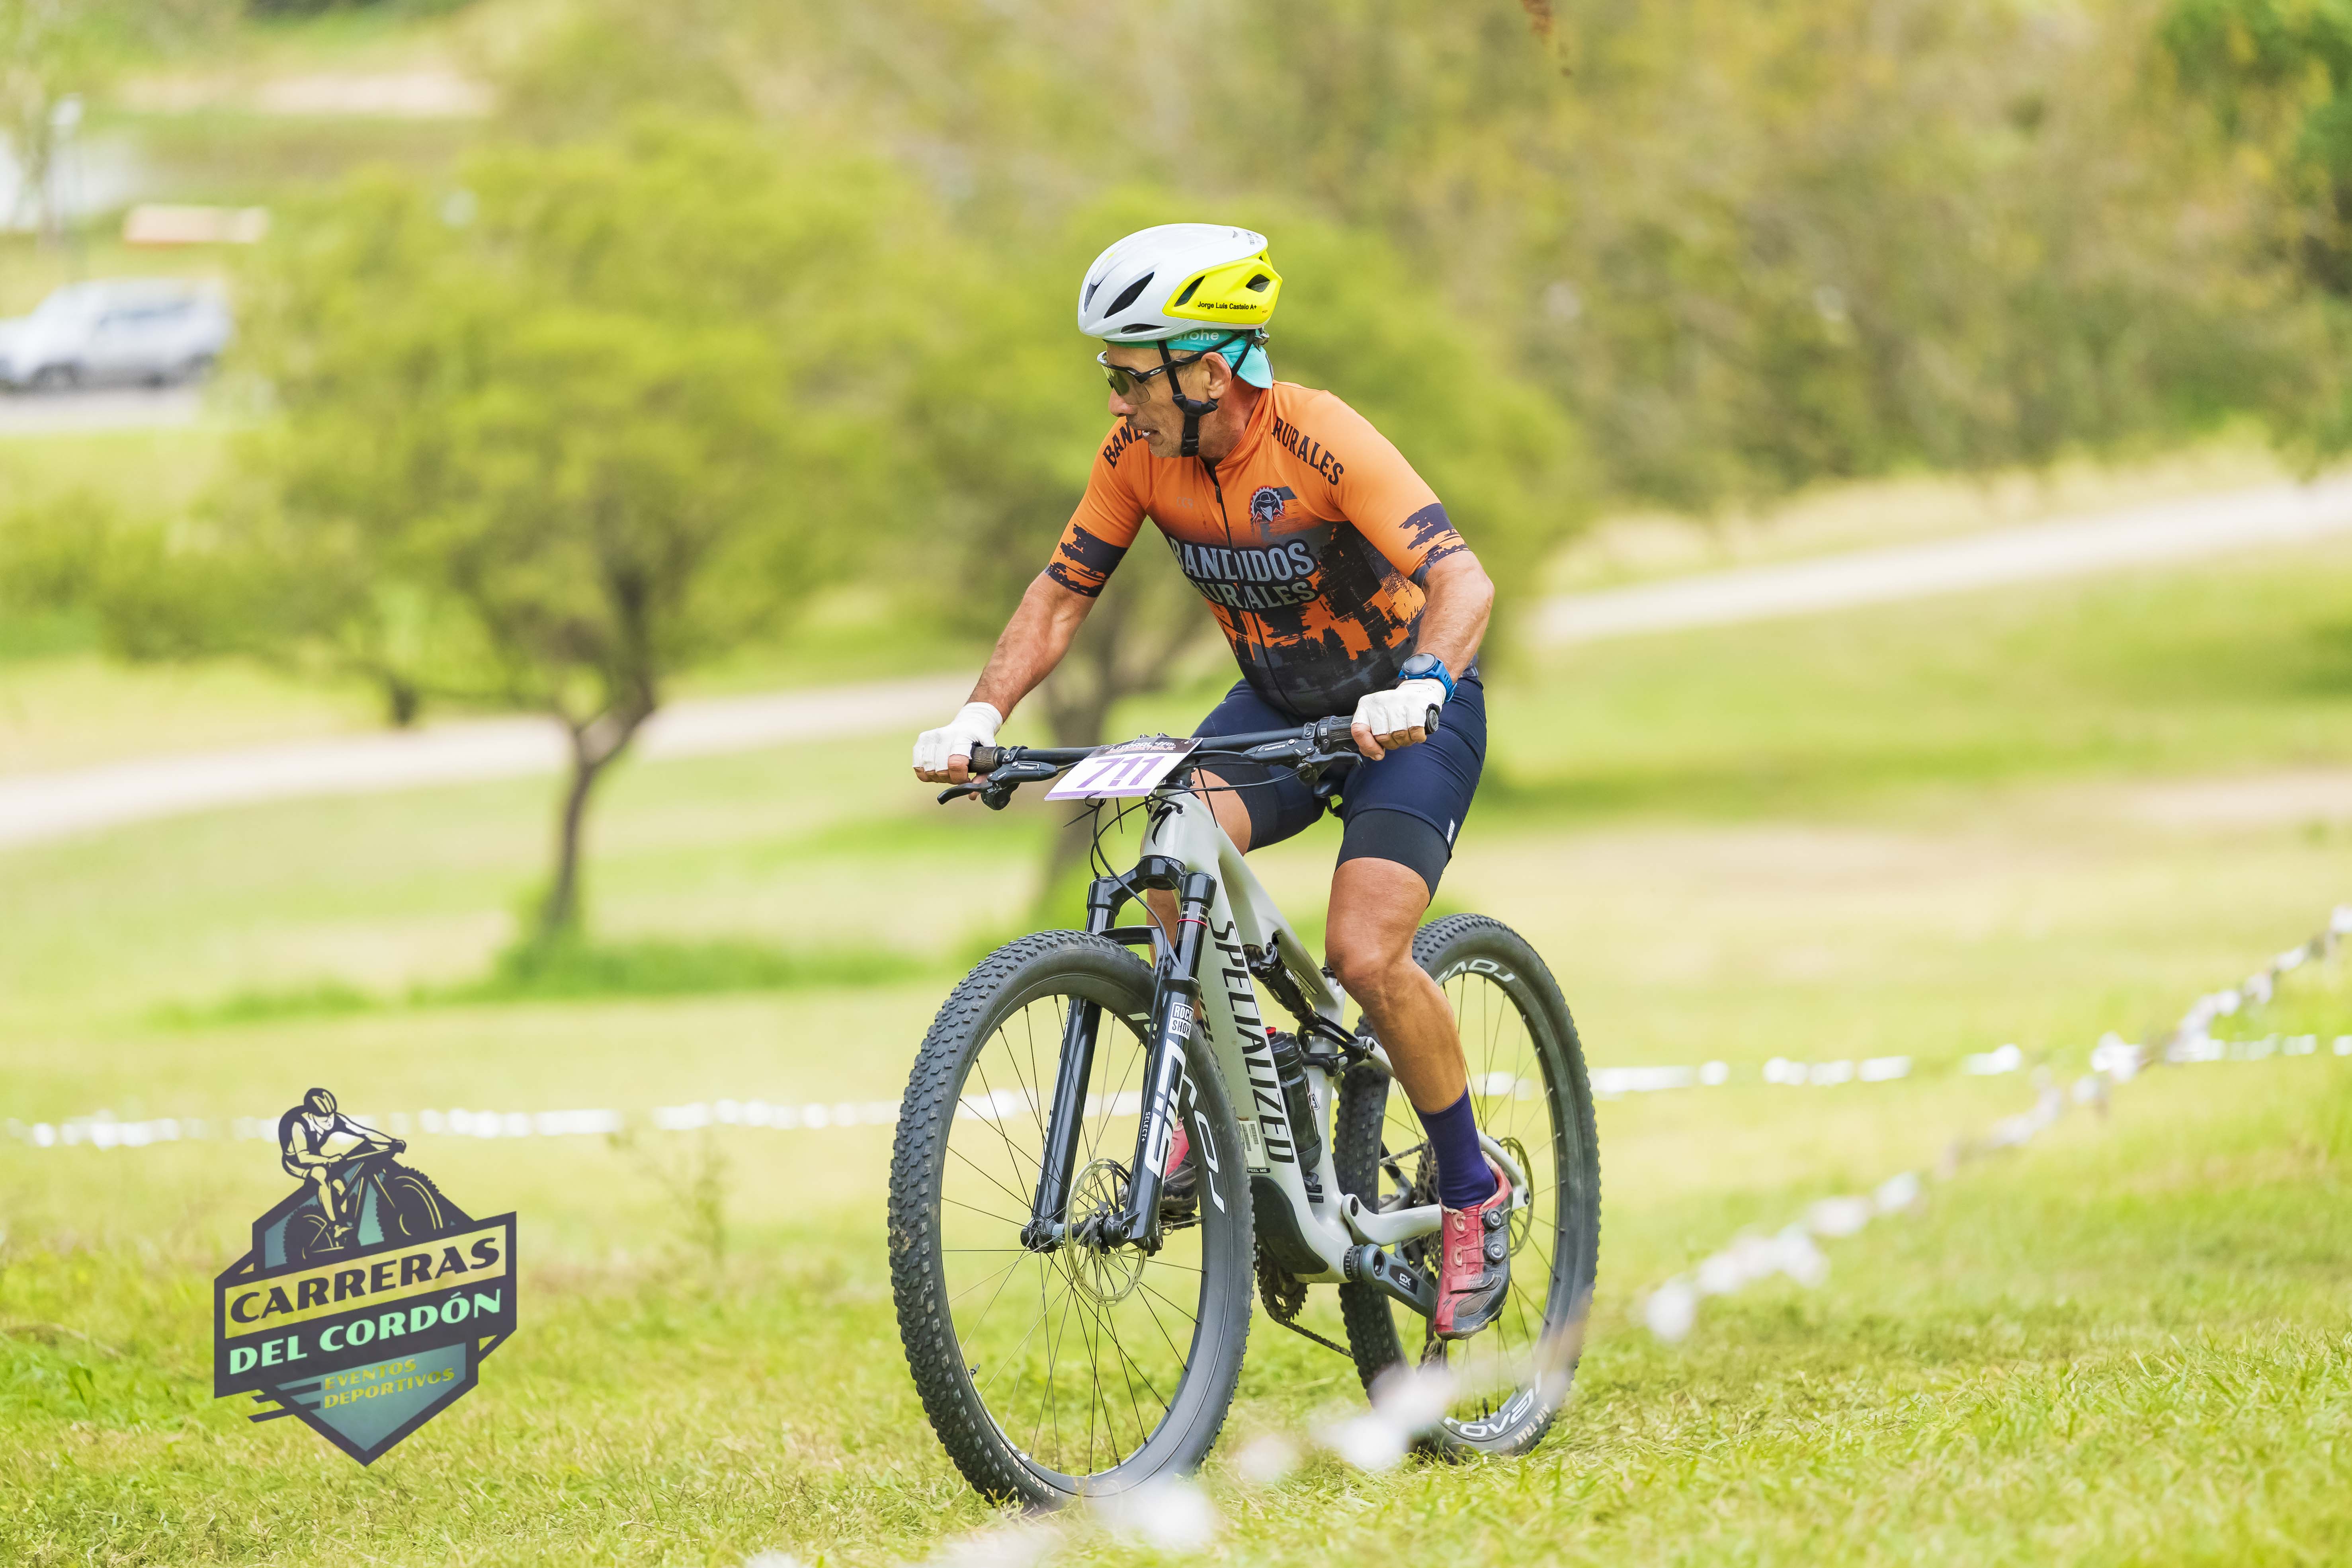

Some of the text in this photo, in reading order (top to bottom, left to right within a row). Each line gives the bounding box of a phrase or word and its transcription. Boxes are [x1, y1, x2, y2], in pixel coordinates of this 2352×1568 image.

[1271, 416, 1344, 485] RURALES
[1169, 537, 1314, 581] BANDIDOS
[1188, 579, 1315, 609] URALES
[1076, 756, 1164, 788] 711
[1172, 1020, 1190, 1036] SHOX
[1174, 1006, 1193, 1023] ROCK
[1208, 917, 1294, 1163] SPECIALIZED
[1141, 1111, 1150, 1142] SELECT+
[1399, 1273, 1411, 1286] GX
[1444, 1370, 1541, 1437] roval
[1029, 1472, 1055, 1497] FAST
